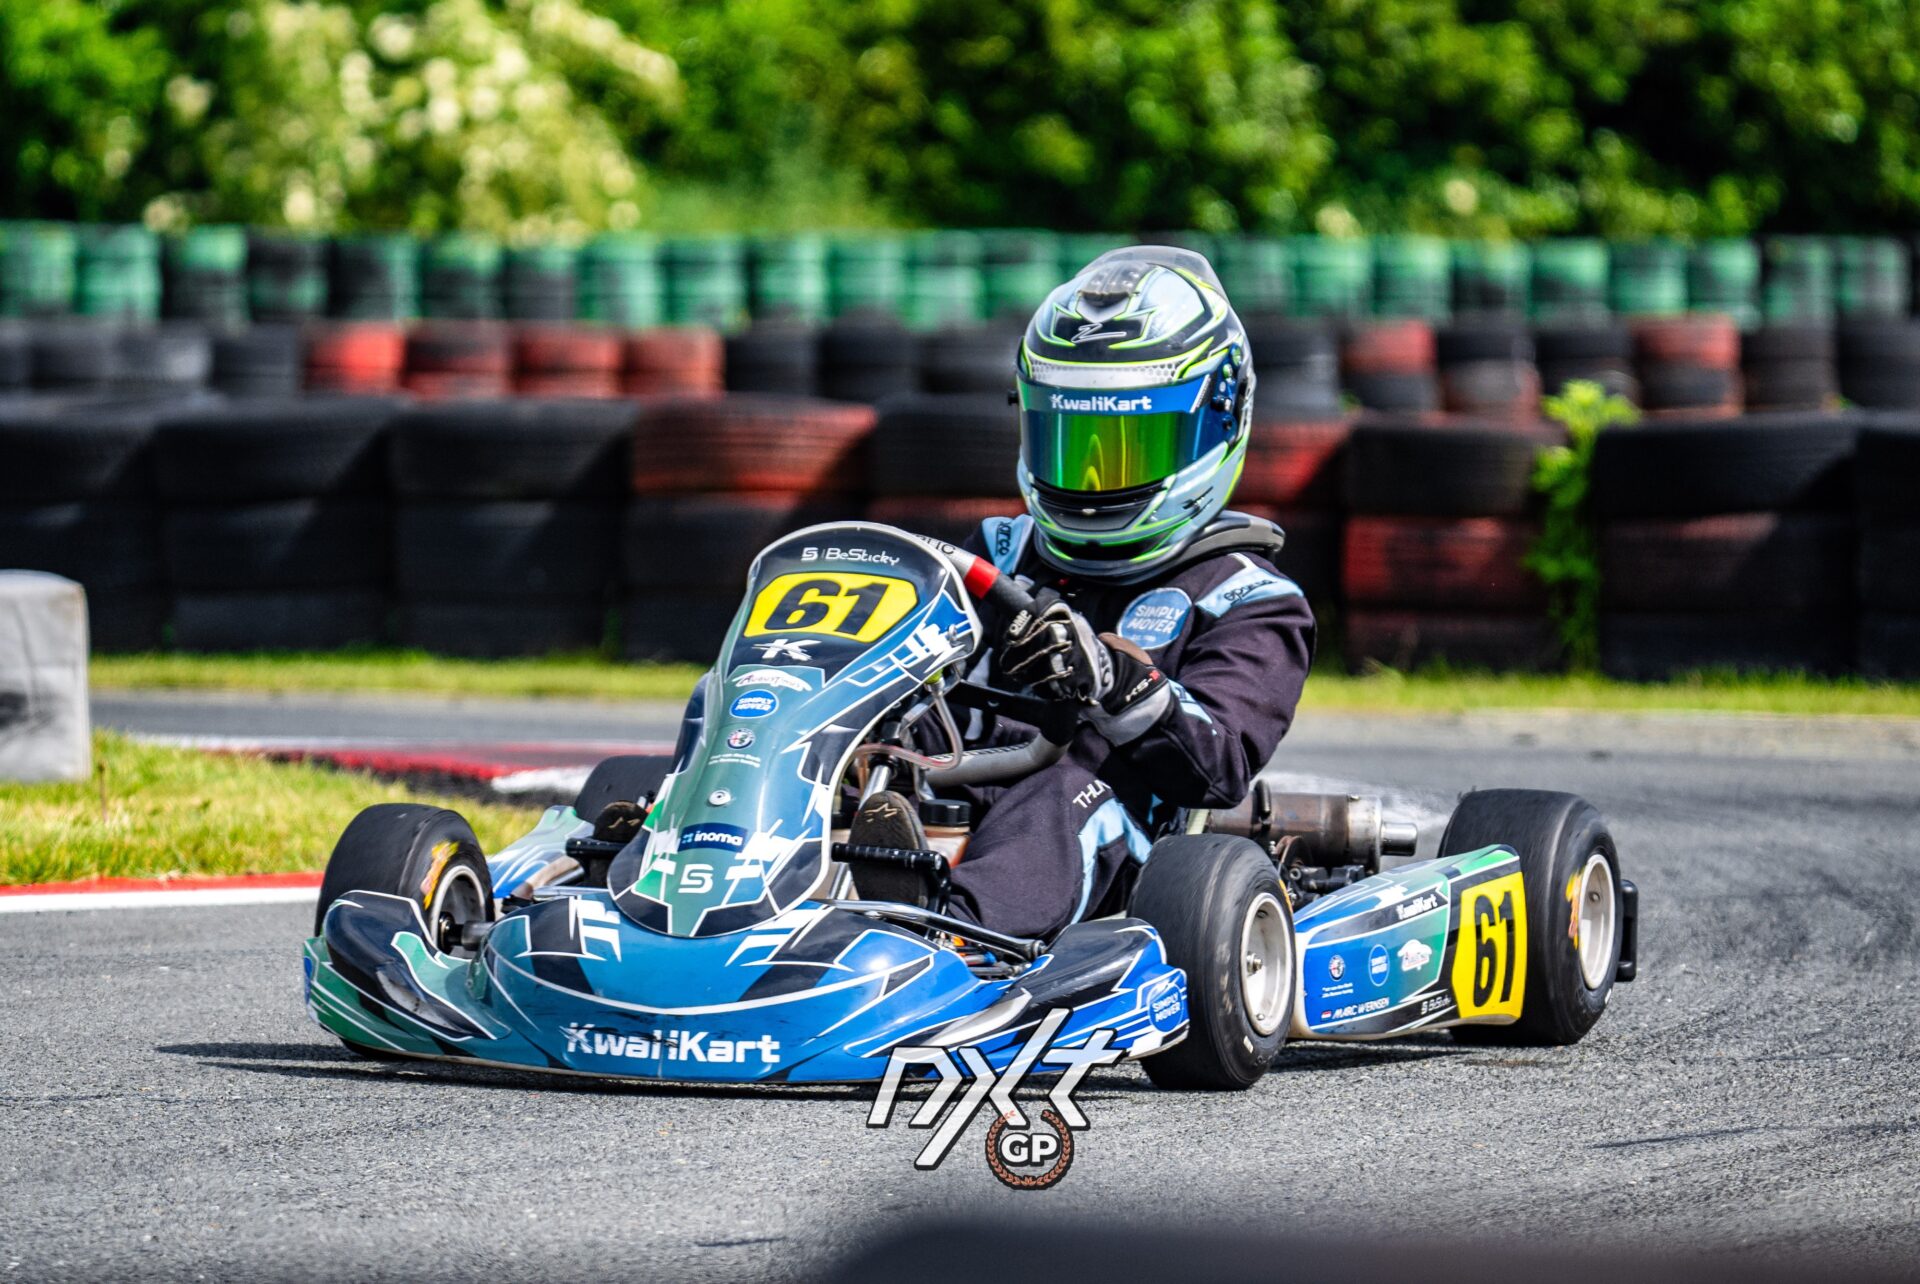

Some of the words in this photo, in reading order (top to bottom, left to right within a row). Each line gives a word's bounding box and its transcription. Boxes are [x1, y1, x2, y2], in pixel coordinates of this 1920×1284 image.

[1049, 394, 1152, 412] KwaliKart
[825, 548, 900, 566] BeSticky
[764, 579, 890, 637] 61
[1135, 604, 1185, 622] SIMPLY
[1008, 610, 1033, 636] OMP
[1126, 617, 1177, 634] MOVER
[694, 831, 743, 847] inoma
[1472, 890, 1516, 1008] 61
[1152, 992, 1180, 1013] SIMPLY
[1154, 1003, 1182, 1024] MOVER
[561, 1021, 781, 1064] KwaliKart
